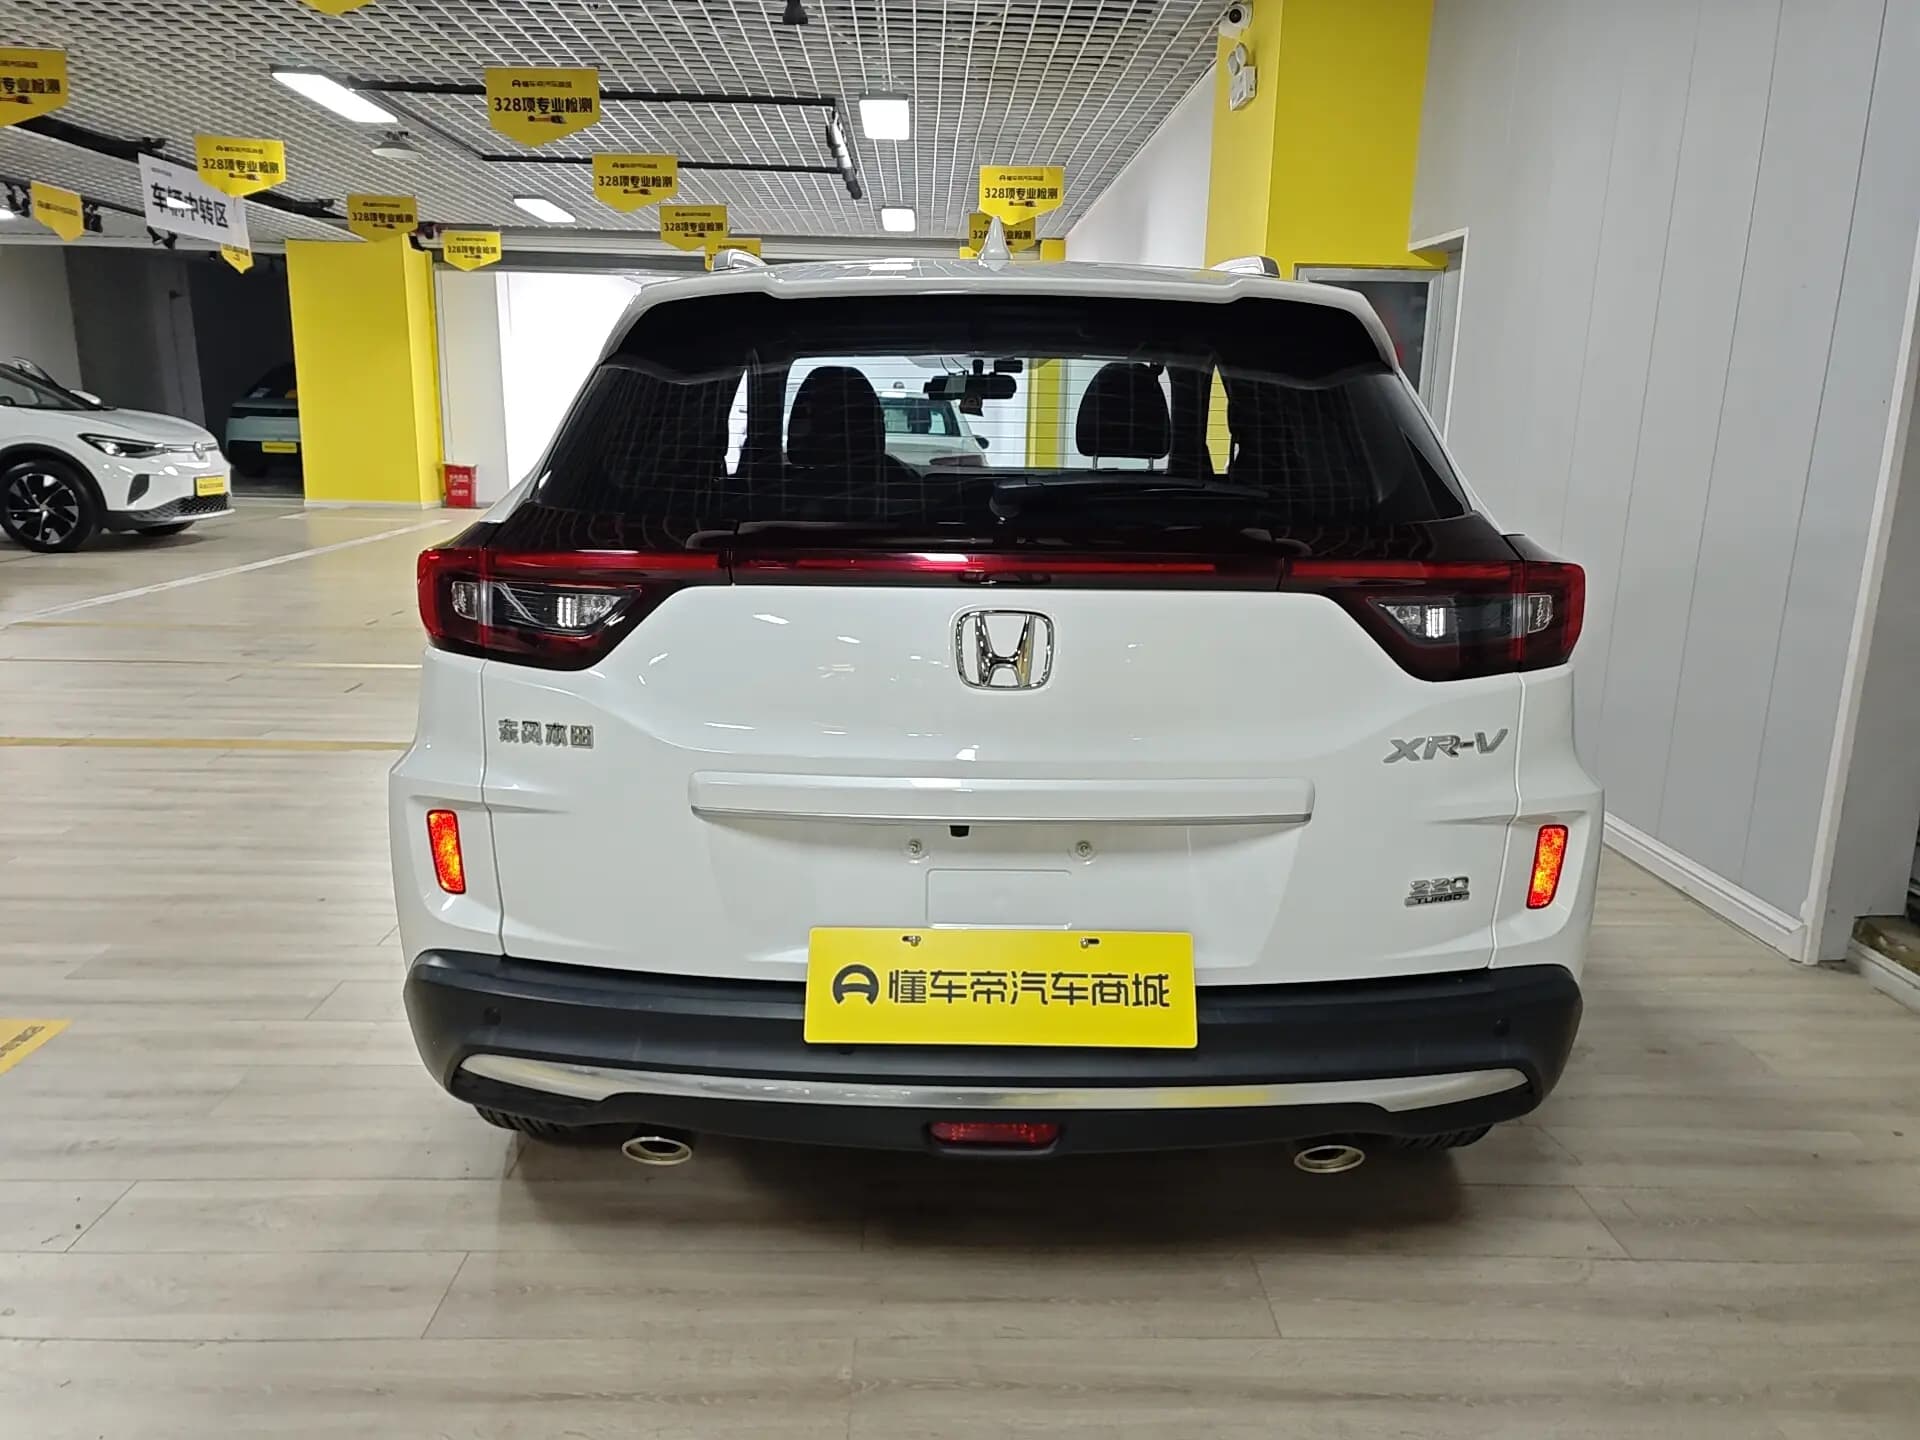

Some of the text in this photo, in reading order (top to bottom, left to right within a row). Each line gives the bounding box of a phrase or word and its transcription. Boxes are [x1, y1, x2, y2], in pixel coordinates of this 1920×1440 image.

[0, 76, 61, 95] 专业检测
[494, 97, 593, 114] 328项专业检测
[202, 158, 280, 174] 328项专业检测
[598, 175, 673, 188] 328项专业检测
[984, 187, 1058, 200] 328项专业检测
[1383, 728, 1509, 763] XR-V
[1409, 876, 1470, 896] 220
[1414, 893, 1463, 905] TURBO
[888, 970, 1170, 1008] 懂车帝汽车商城
